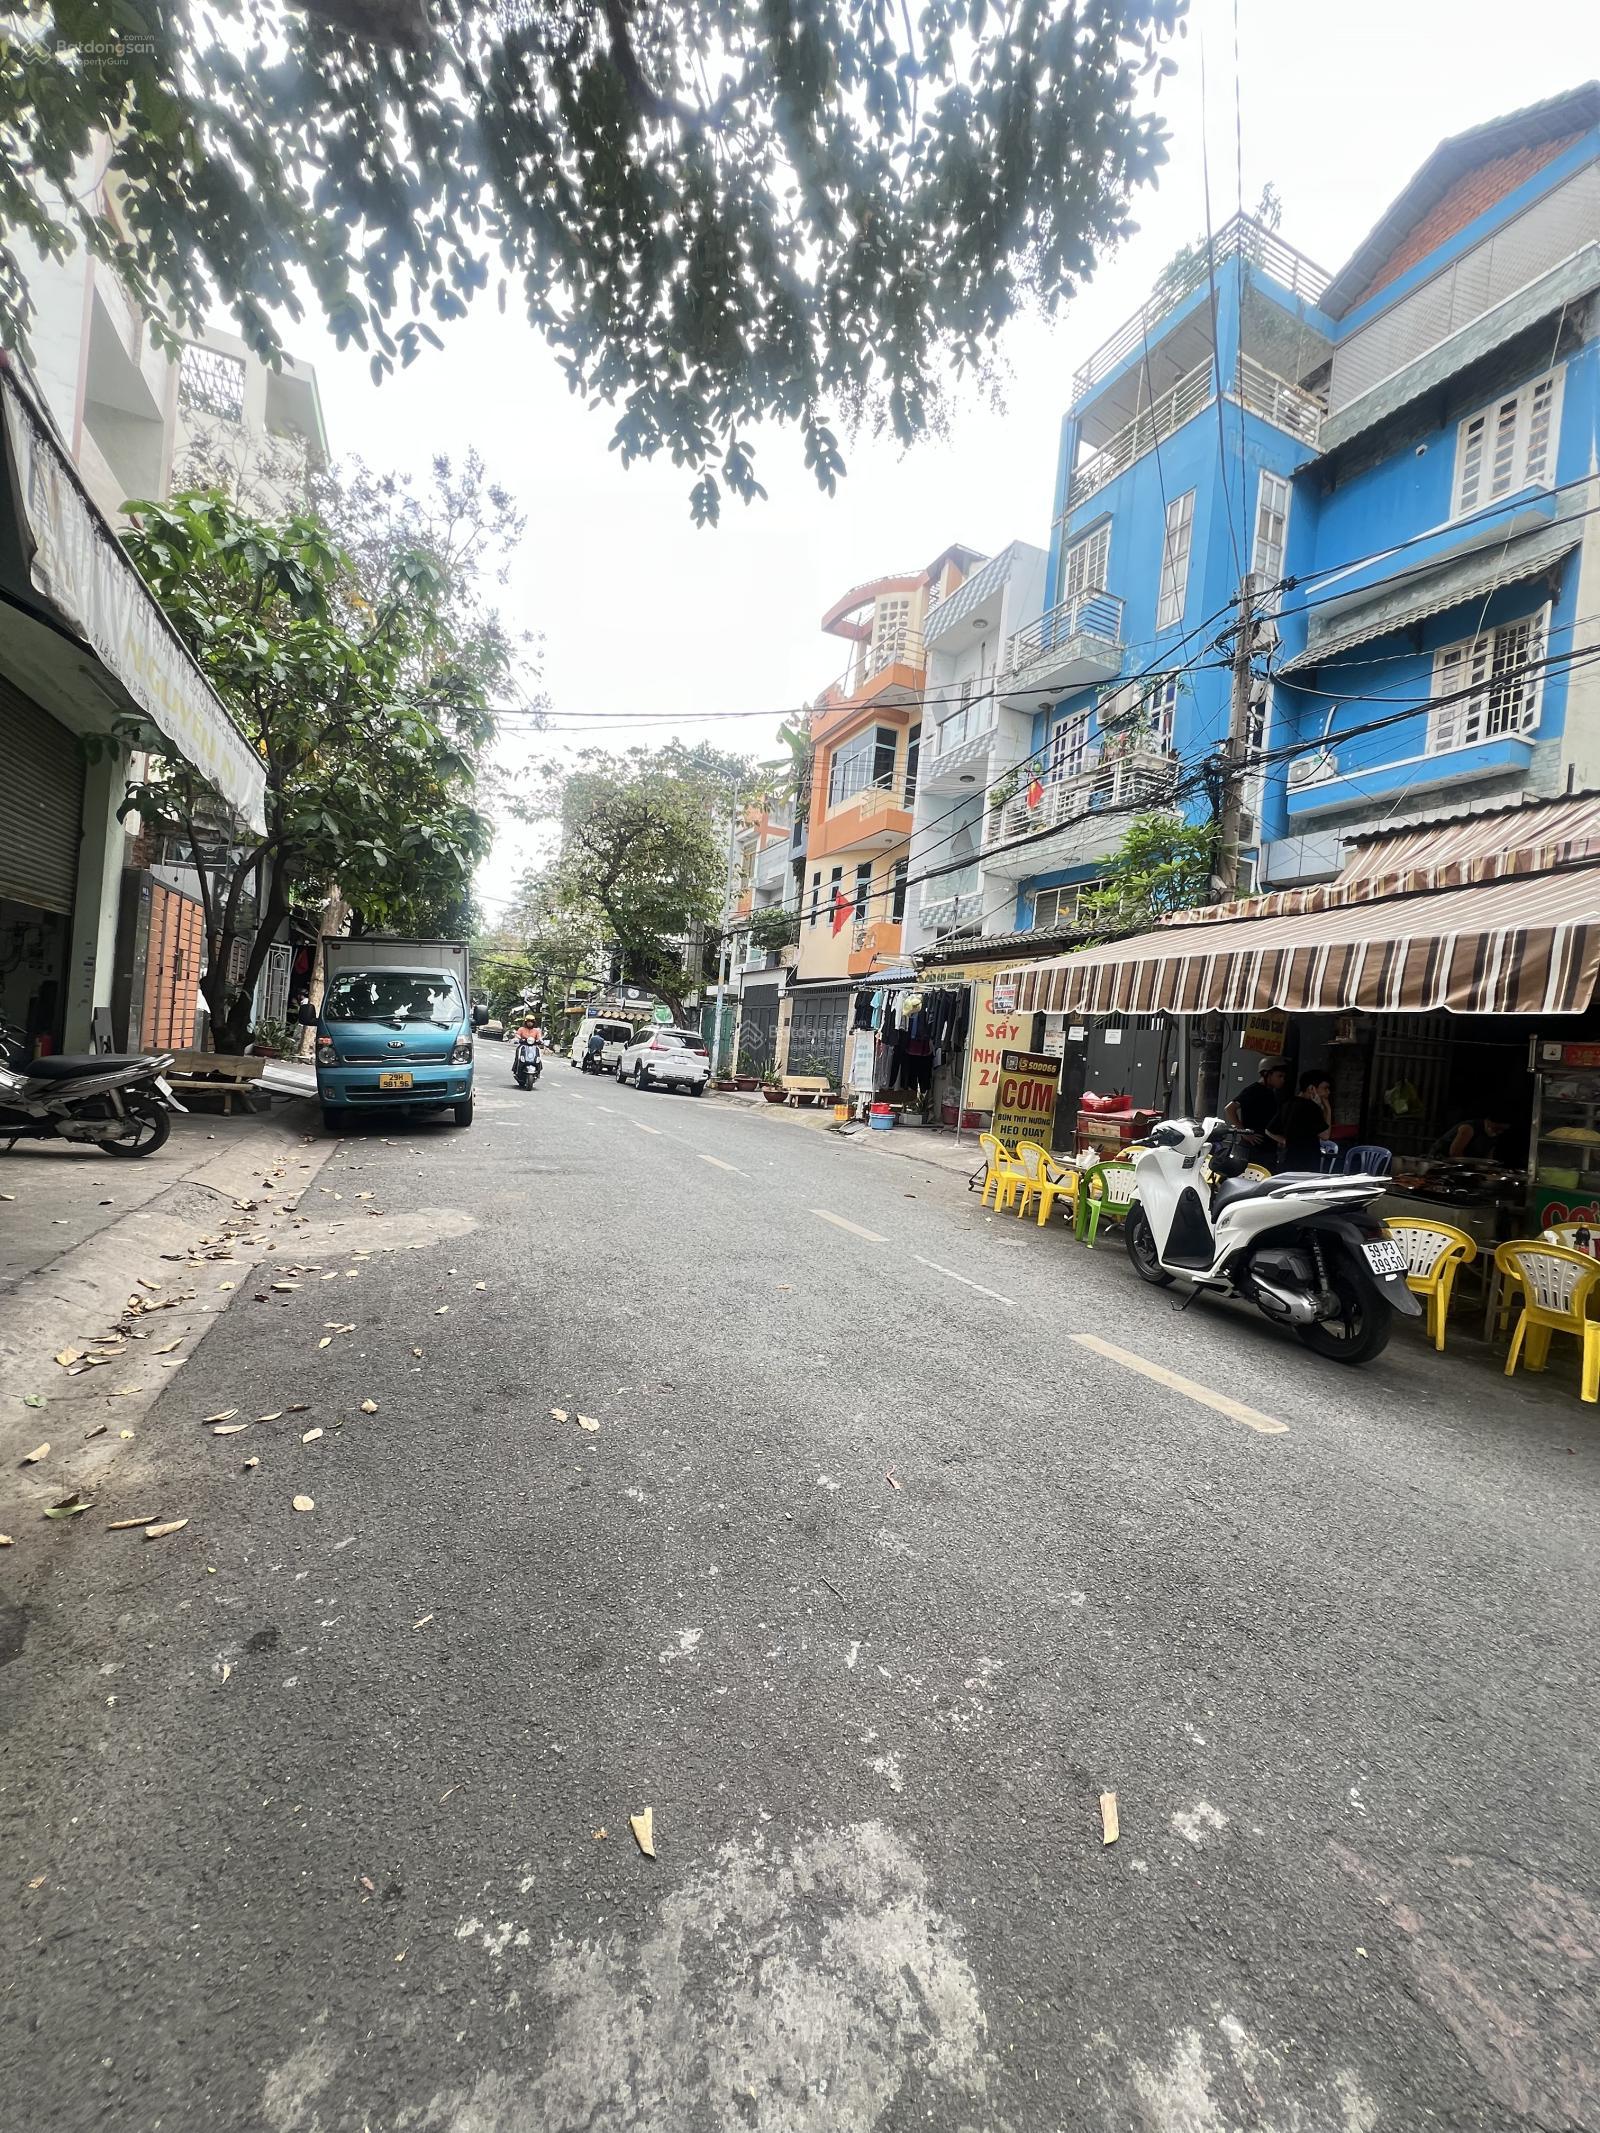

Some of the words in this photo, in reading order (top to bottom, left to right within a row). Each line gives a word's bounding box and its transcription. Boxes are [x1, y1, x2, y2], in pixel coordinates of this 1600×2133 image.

[985, 1020, 1020, 1041] SẤY
[1001, 1078, 1053, 1112] CƠM
[1000, 1125, 1019, 1135] HEO
[1022, 1127, 1046, 1137] QUAY
[1367, 1242, 1396, 1258] 59-P3
[1371, 1255, 1405, 1273] 399.50
